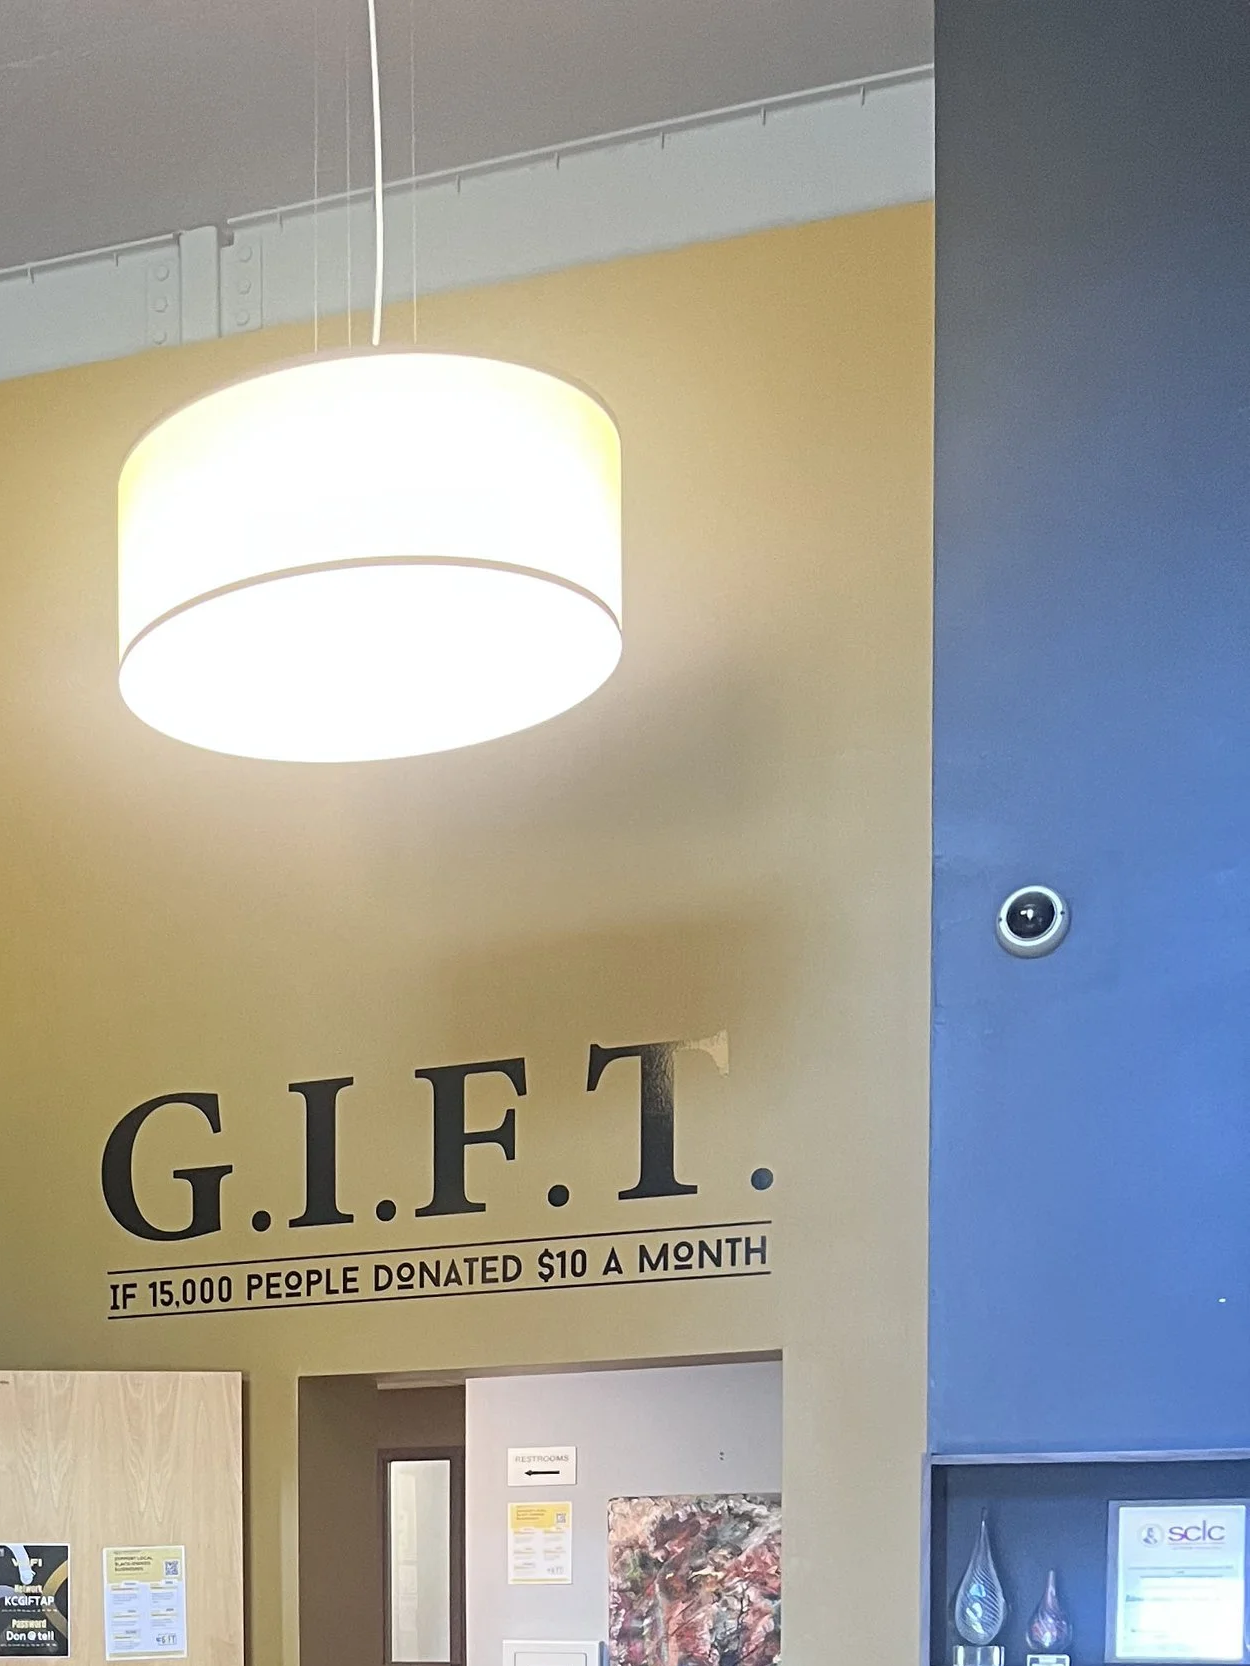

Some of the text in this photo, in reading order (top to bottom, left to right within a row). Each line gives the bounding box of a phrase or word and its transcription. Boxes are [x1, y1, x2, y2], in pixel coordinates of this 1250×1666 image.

[101, 1029, 774, 1242] G.I.F.T.
[109, 1235, 767, 1310] IF 15,000 PEOPLE DONATED $10 A MONTH
[515, 1455, 569, 1463] RESTROOMS
[1168, 1519, 1226, 1542] sclc
